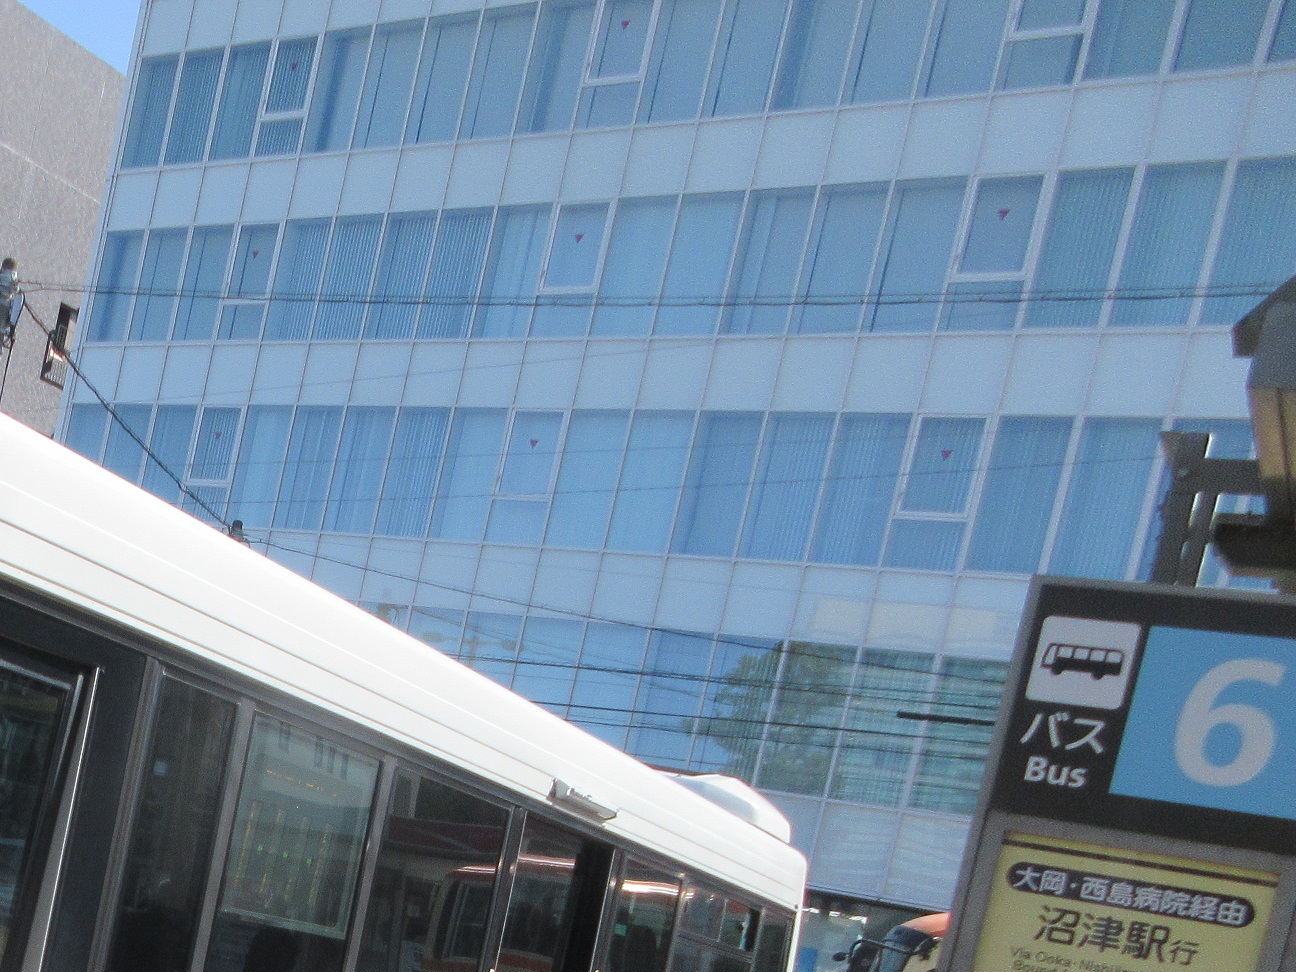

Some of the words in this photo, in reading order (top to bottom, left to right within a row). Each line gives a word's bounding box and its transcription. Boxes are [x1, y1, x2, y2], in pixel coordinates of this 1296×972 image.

[1019, 708, 1106, 757] バス
[1174, 657, 1288, 788] 6
[1024, 756, 1087, 789] Bus
[1013, 864, 1249, 928] 大岡・西島病院経由
